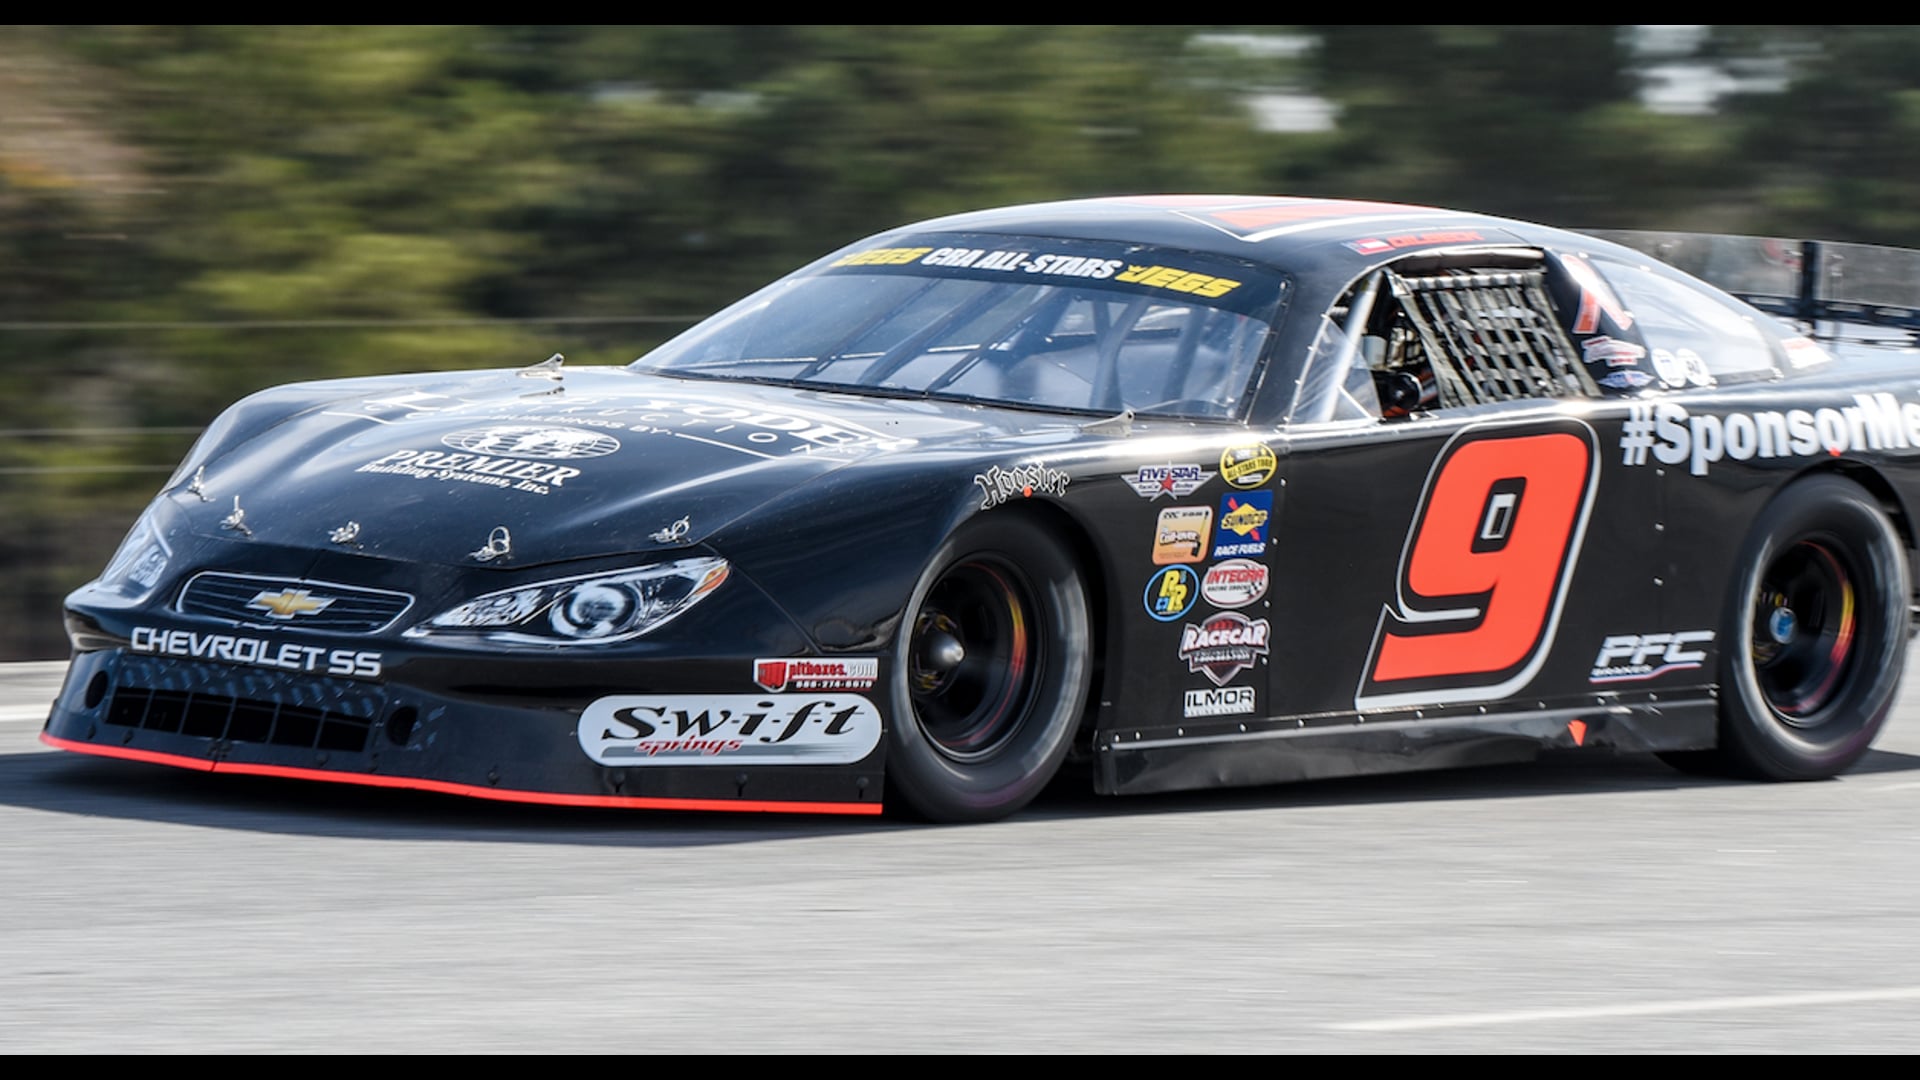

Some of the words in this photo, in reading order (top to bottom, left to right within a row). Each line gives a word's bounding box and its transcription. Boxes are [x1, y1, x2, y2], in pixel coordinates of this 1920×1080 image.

[920, 247, 985, 268] CRA
[971, 250, 1123, 279] ALL-STARS
[1115, 255, 1242, 298] JEGS
[354, 464, 435, 479] Building
[512, 480, 550, 495] Inc.
[372, 450, 581, 487] PREMIER
[1139, 467, 1169, 483] FIVE
[1170, 466, 1200, 481] STAR
[974, 461, 1071, 511] Hoosier
[1222, 510, 1268, 528] SUNOCO
[1213, 544, 1239, 557] RACE
[1238, 542, 1267, 555] FUELS
[1206, 568, 1266, 585] INTEGRA
[1357, 418, 1600, 710] 9
[131, 626, 326, 672] CHEVROLET
[328, 651, 383, 677] SS
[1183, 624, 1266, 652] RACECAR
[1594, 630, 1717, 668] PFC
[788, 660, 877, 680] pitboxes.com
[1187, 690, 1253, 708] ILMOR
[635, 736, 744, 757] springs
